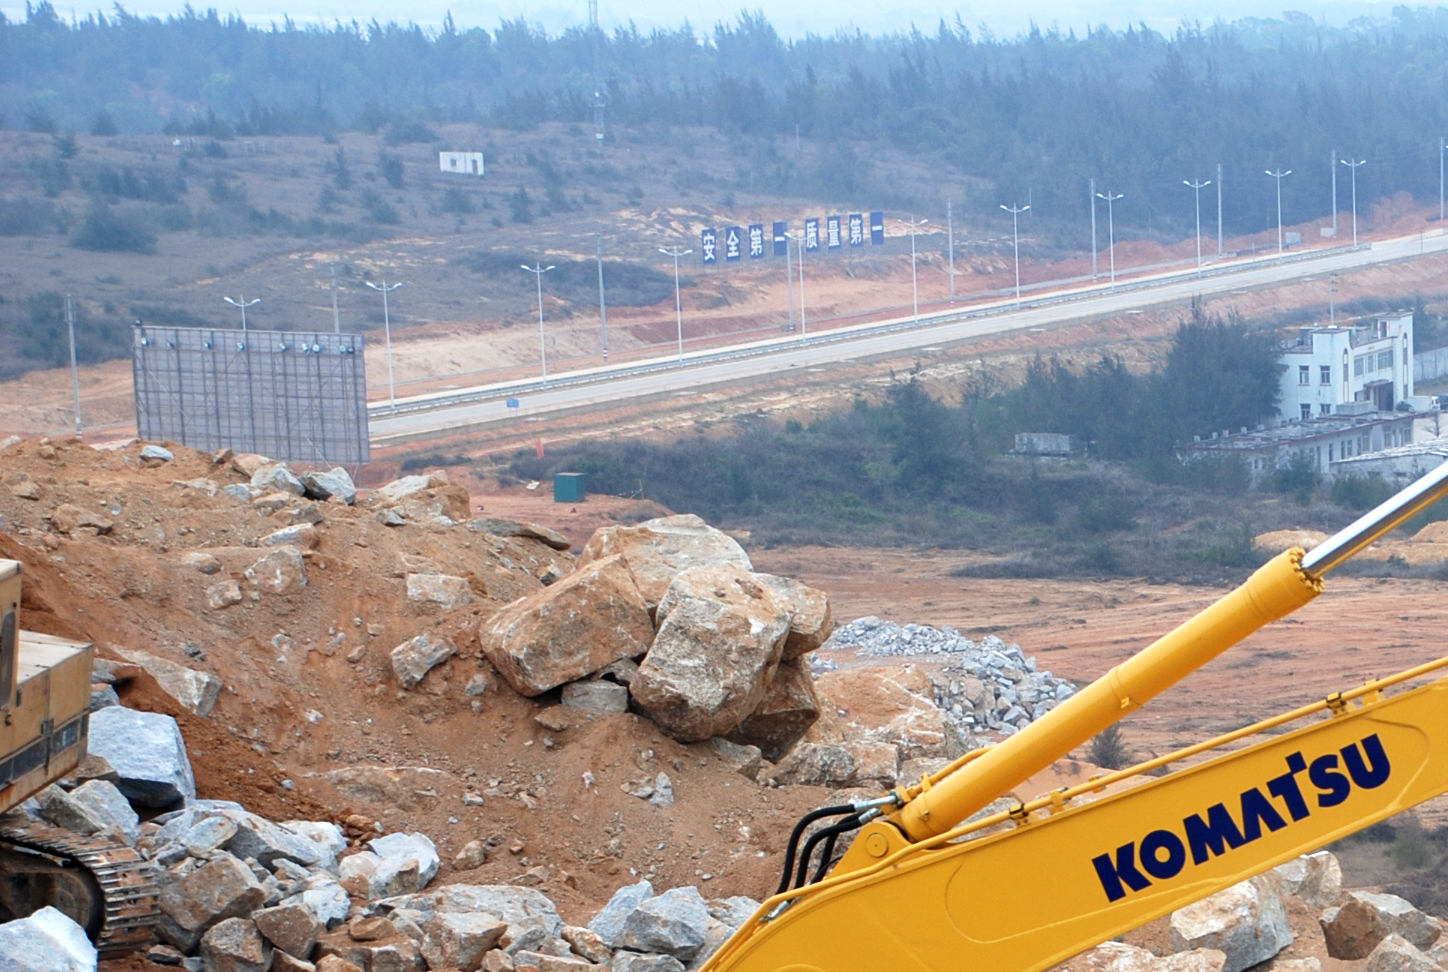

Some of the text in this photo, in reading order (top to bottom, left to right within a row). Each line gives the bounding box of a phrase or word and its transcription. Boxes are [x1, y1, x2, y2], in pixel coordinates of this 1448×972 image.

[703, 218, 883, 261] 安全第一 质量第一
[1091, 733, 1391, 903] KOMATSU
